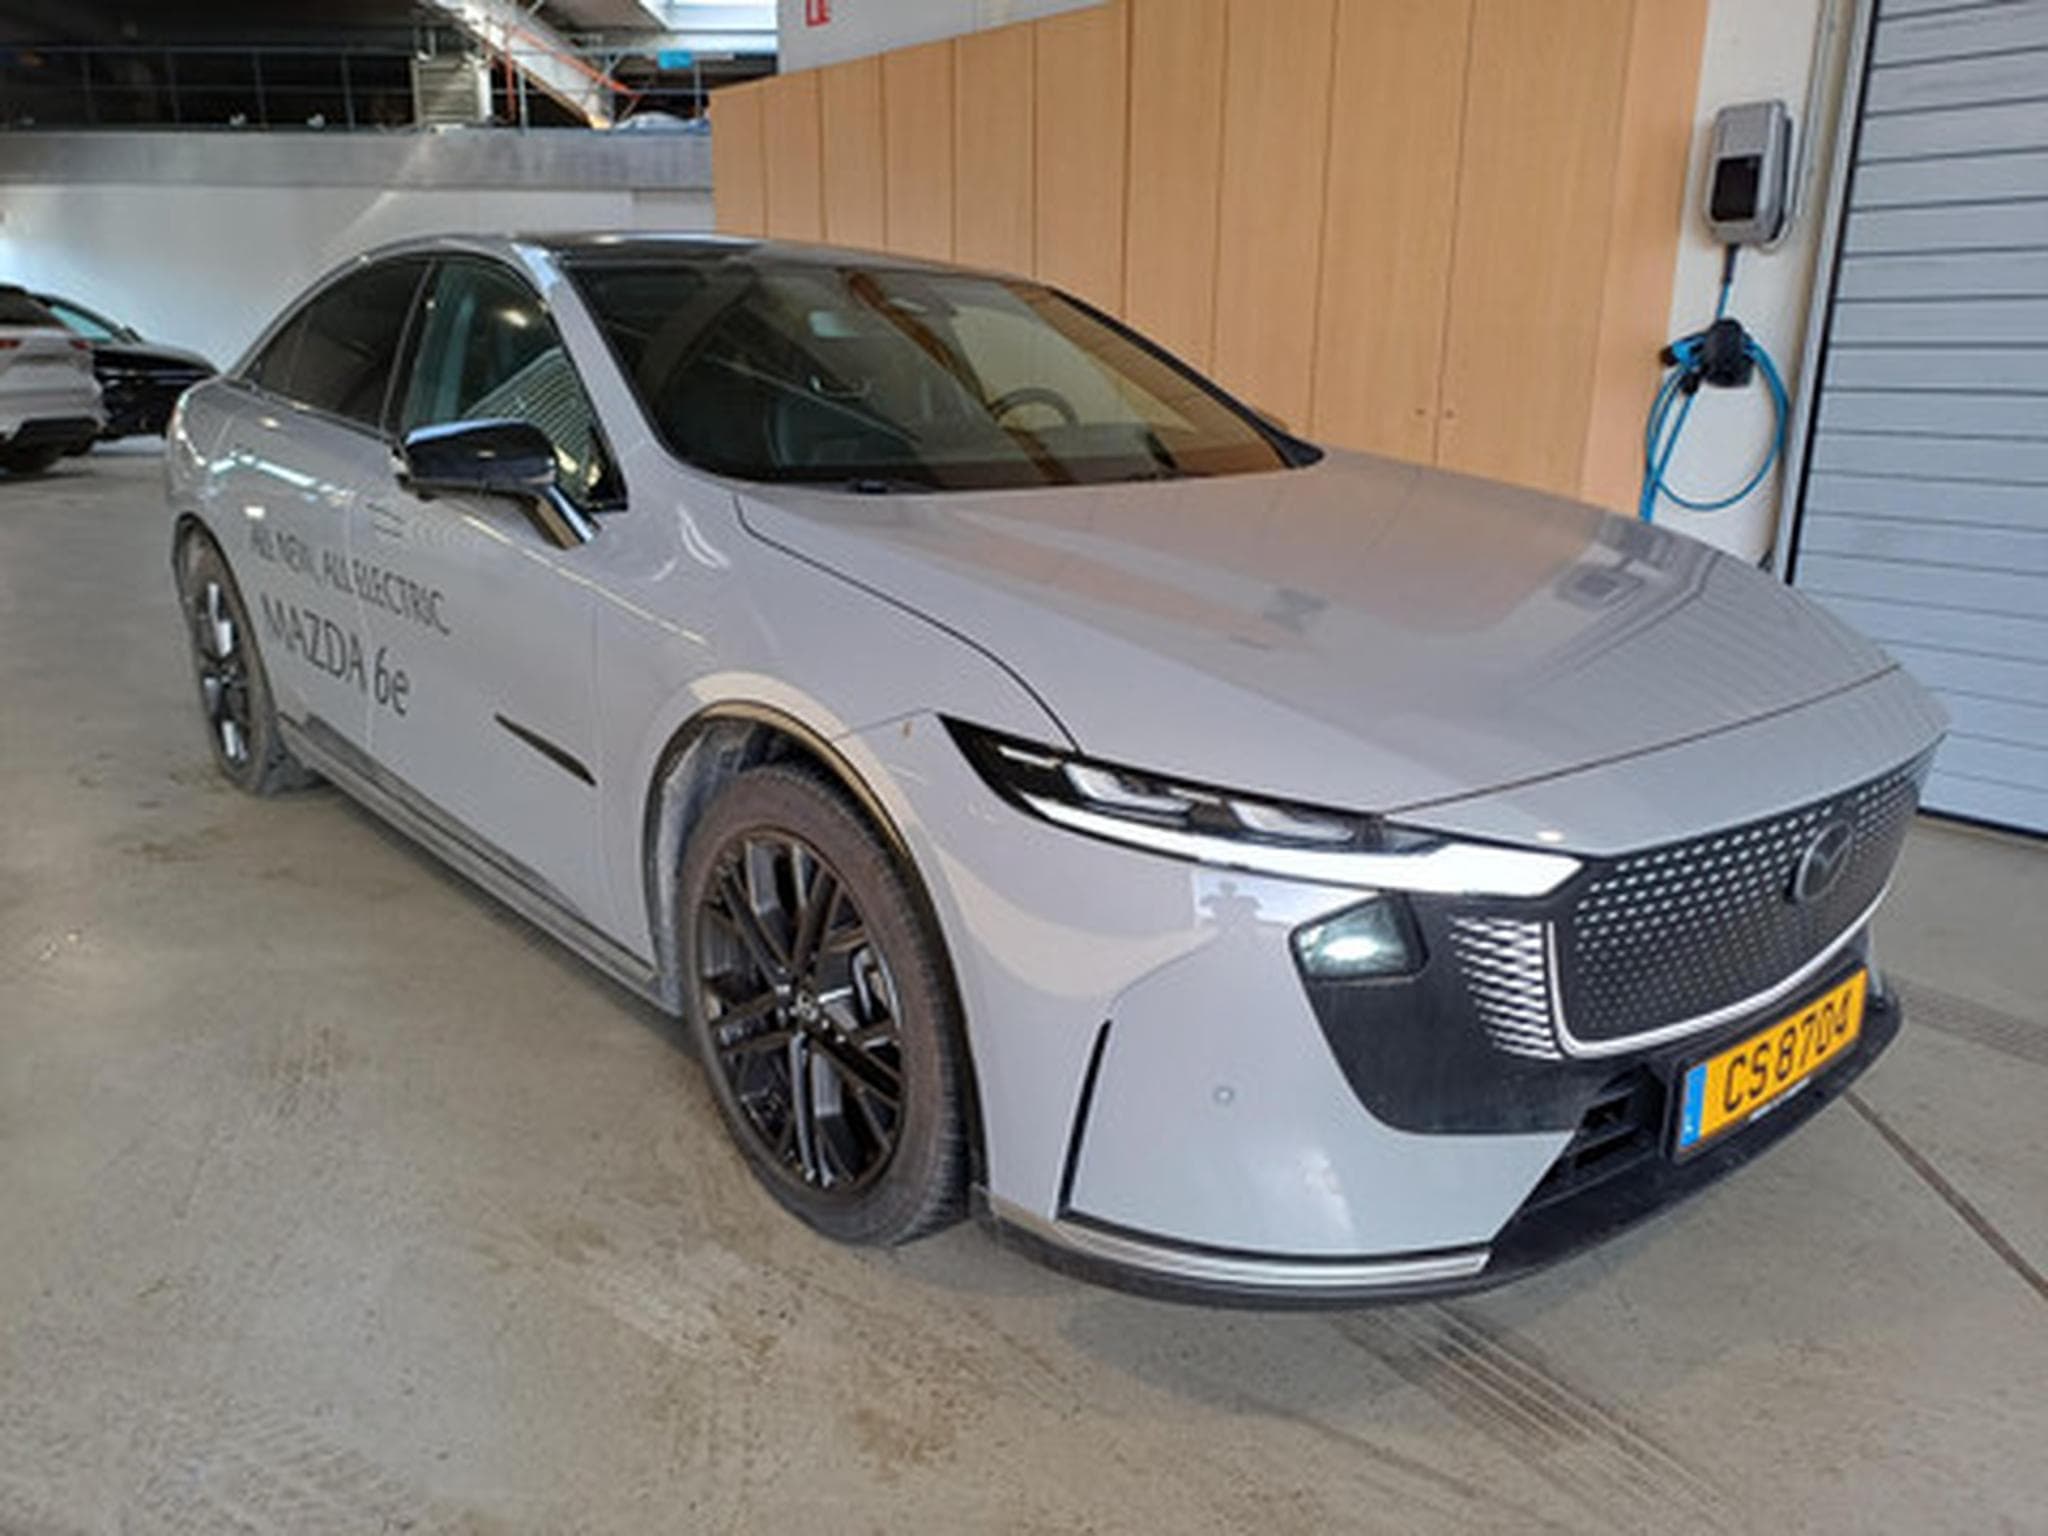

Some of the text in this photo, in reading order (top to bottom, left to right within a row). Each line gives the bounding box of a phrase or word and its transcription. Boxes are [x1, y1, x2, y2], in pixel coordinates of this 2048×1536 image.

[322, 550, 354, 594] ALL
[352, 557, 450, 636] ELECTRIC
[260, 591, 409, 716] MAZDA 6e
